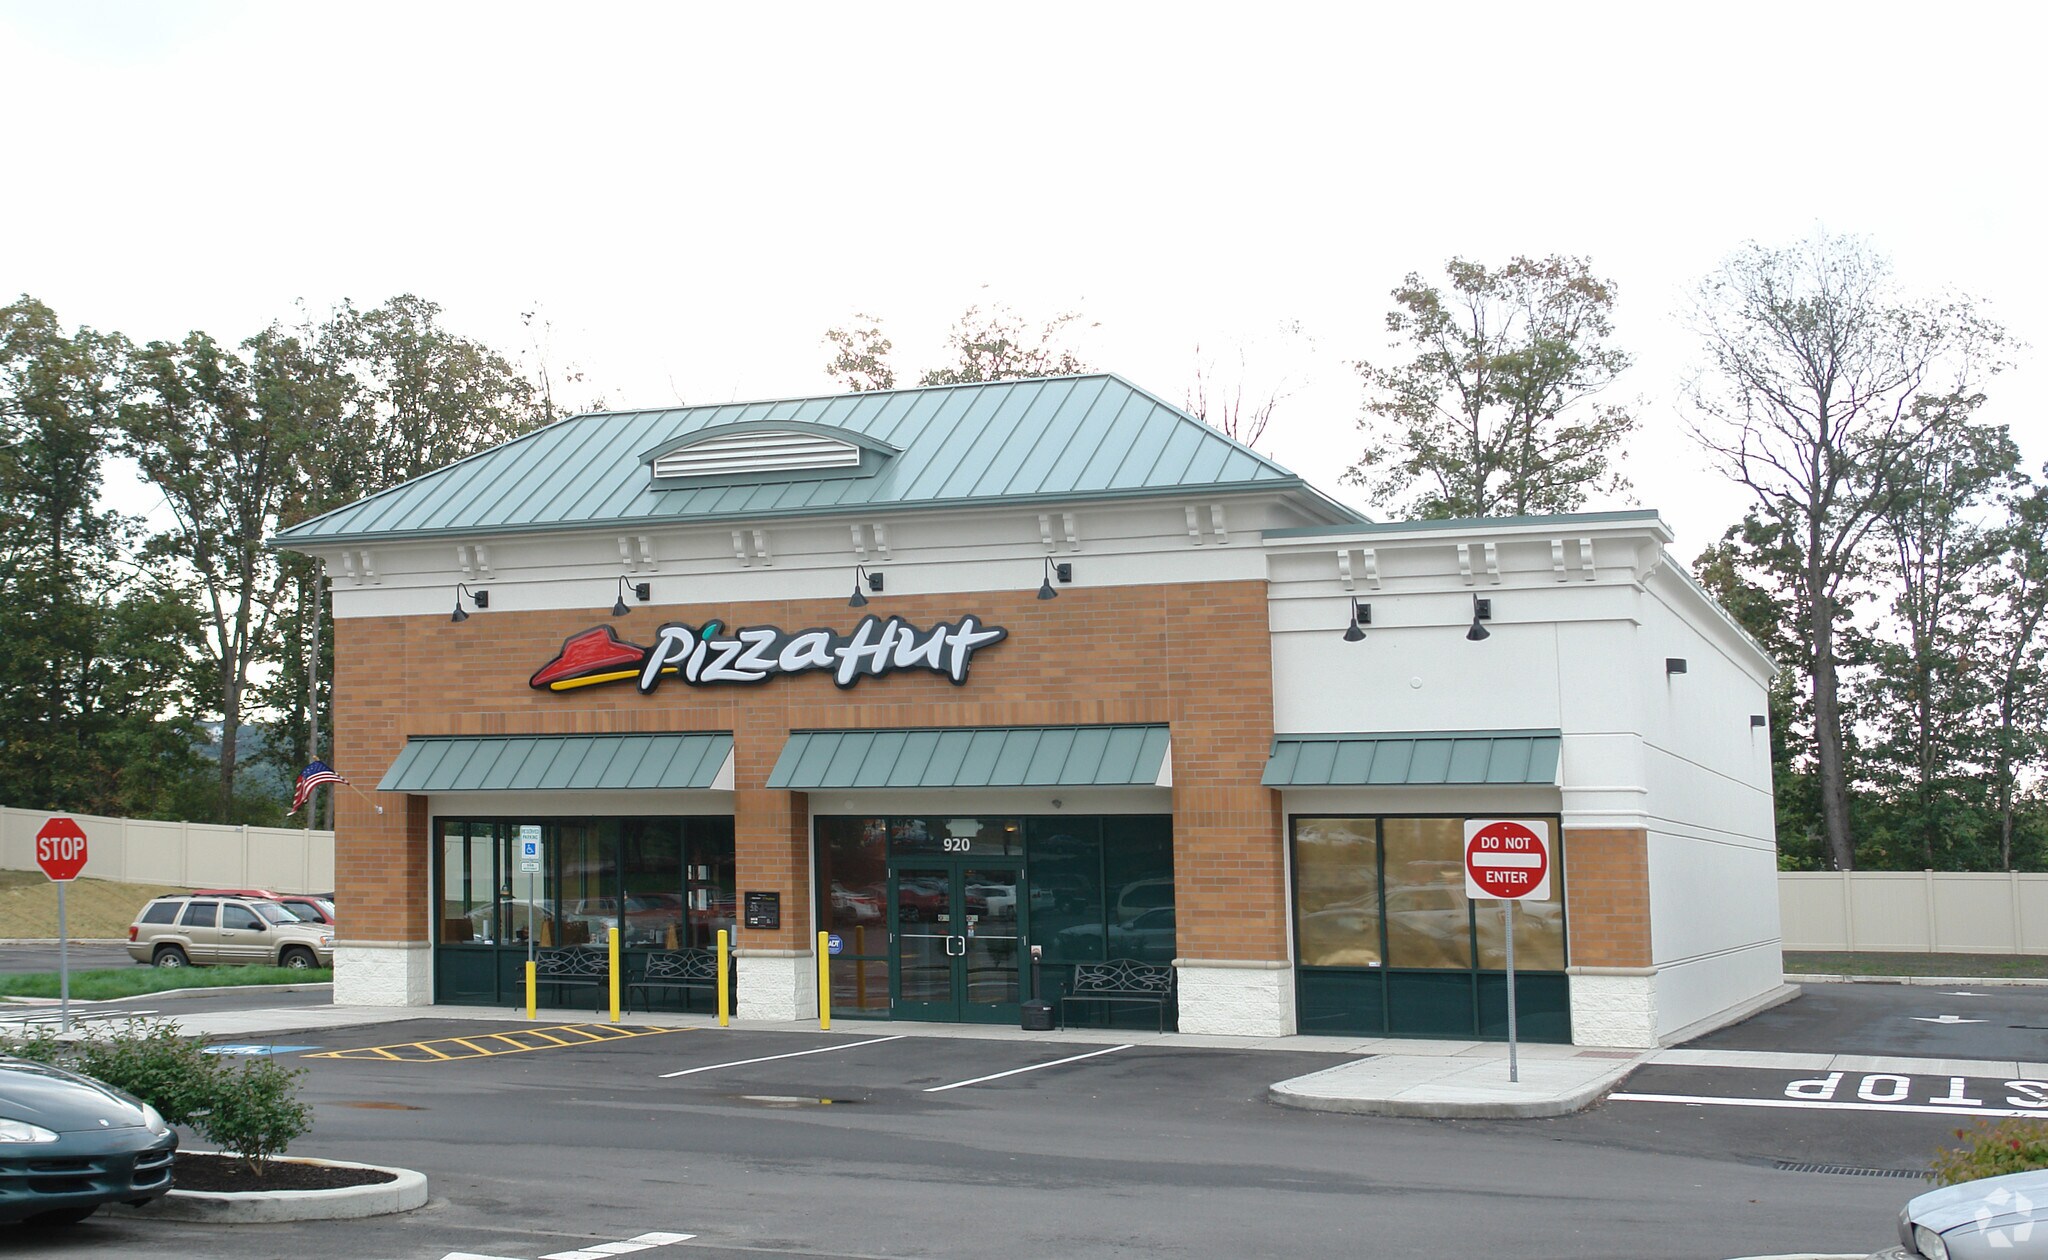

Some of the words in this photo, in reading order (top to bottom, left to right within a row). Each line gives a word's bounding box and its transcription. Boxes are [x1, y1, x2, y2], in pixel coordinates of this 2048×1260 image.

[641, 623, 834, 690] Pizza
[834, 619, 1001, 685] Hut
[39, 837, 85, 861] STOP
[943, 838, 971, 852] 920
[1481, 837, 1500, 849] DO
[1505, 837, 1531, 850] NOT
[1486, 871, 1529, 884] ENTER
[828, 940, 840, 948] ADT
[1784, 1072, 2048, 1108] STOP
